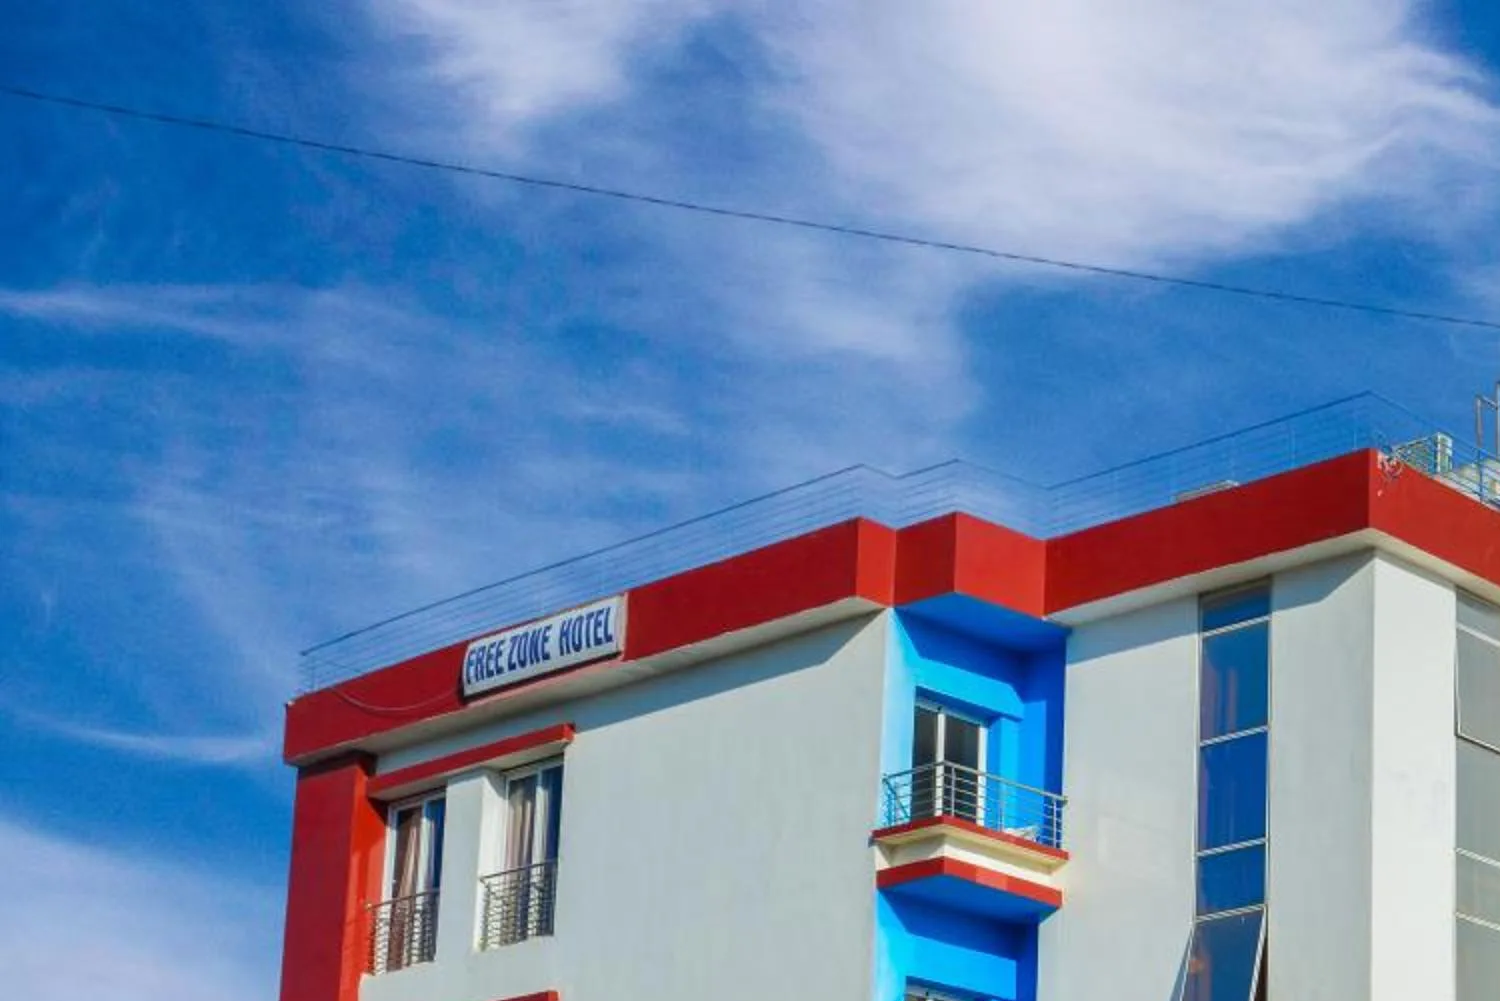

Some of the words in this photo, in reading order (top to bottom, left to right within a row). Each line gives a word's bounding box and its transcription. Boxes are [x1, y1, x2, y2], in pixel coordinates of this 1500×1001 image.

[467, 639, 507, 684] FREE
[507, 624, 553, 671] ZONE
[559, 606, 614, 657] HOTEL
